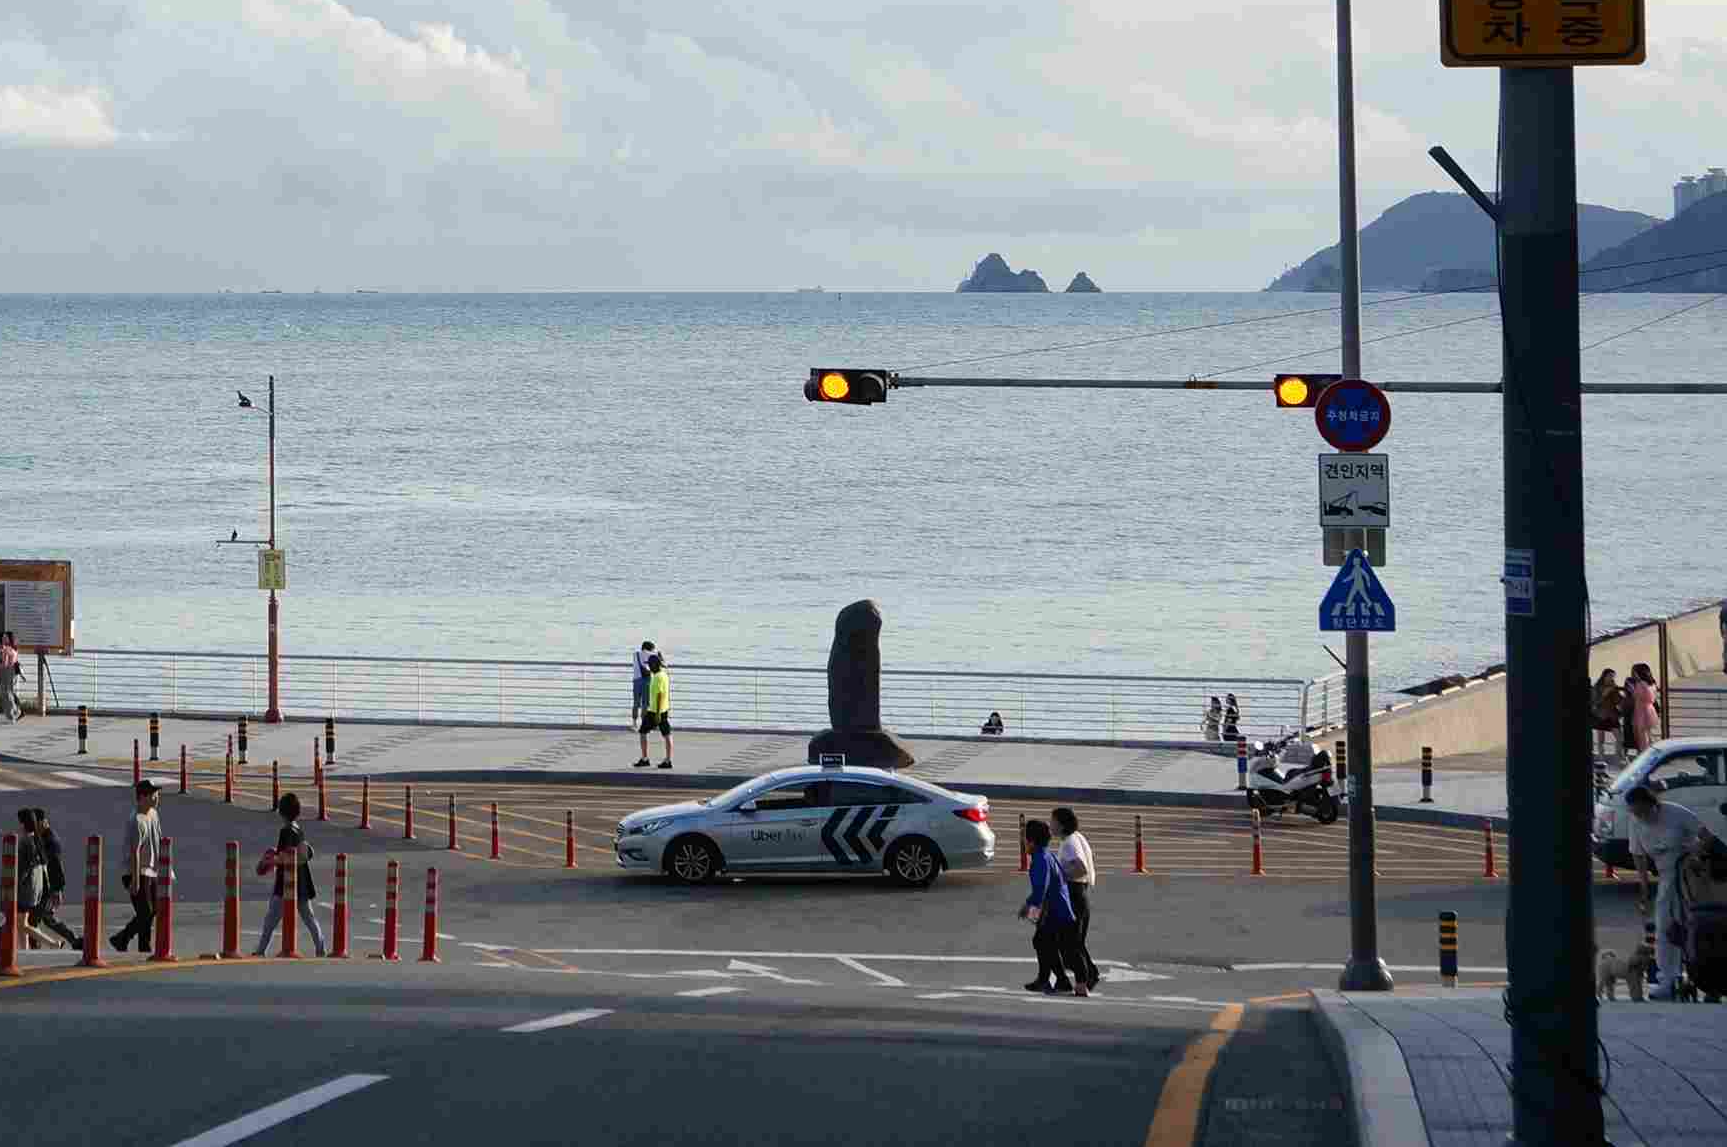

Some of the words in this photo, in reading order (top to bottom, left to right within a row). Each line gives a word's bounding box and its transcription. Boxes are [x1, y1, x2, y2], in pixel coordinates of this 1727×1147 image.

[1324, 462, 1385, 480] 견인지역
[1332, 616, 1387, 630] 횡단보도
[751, 829, 781, 841] Uber
